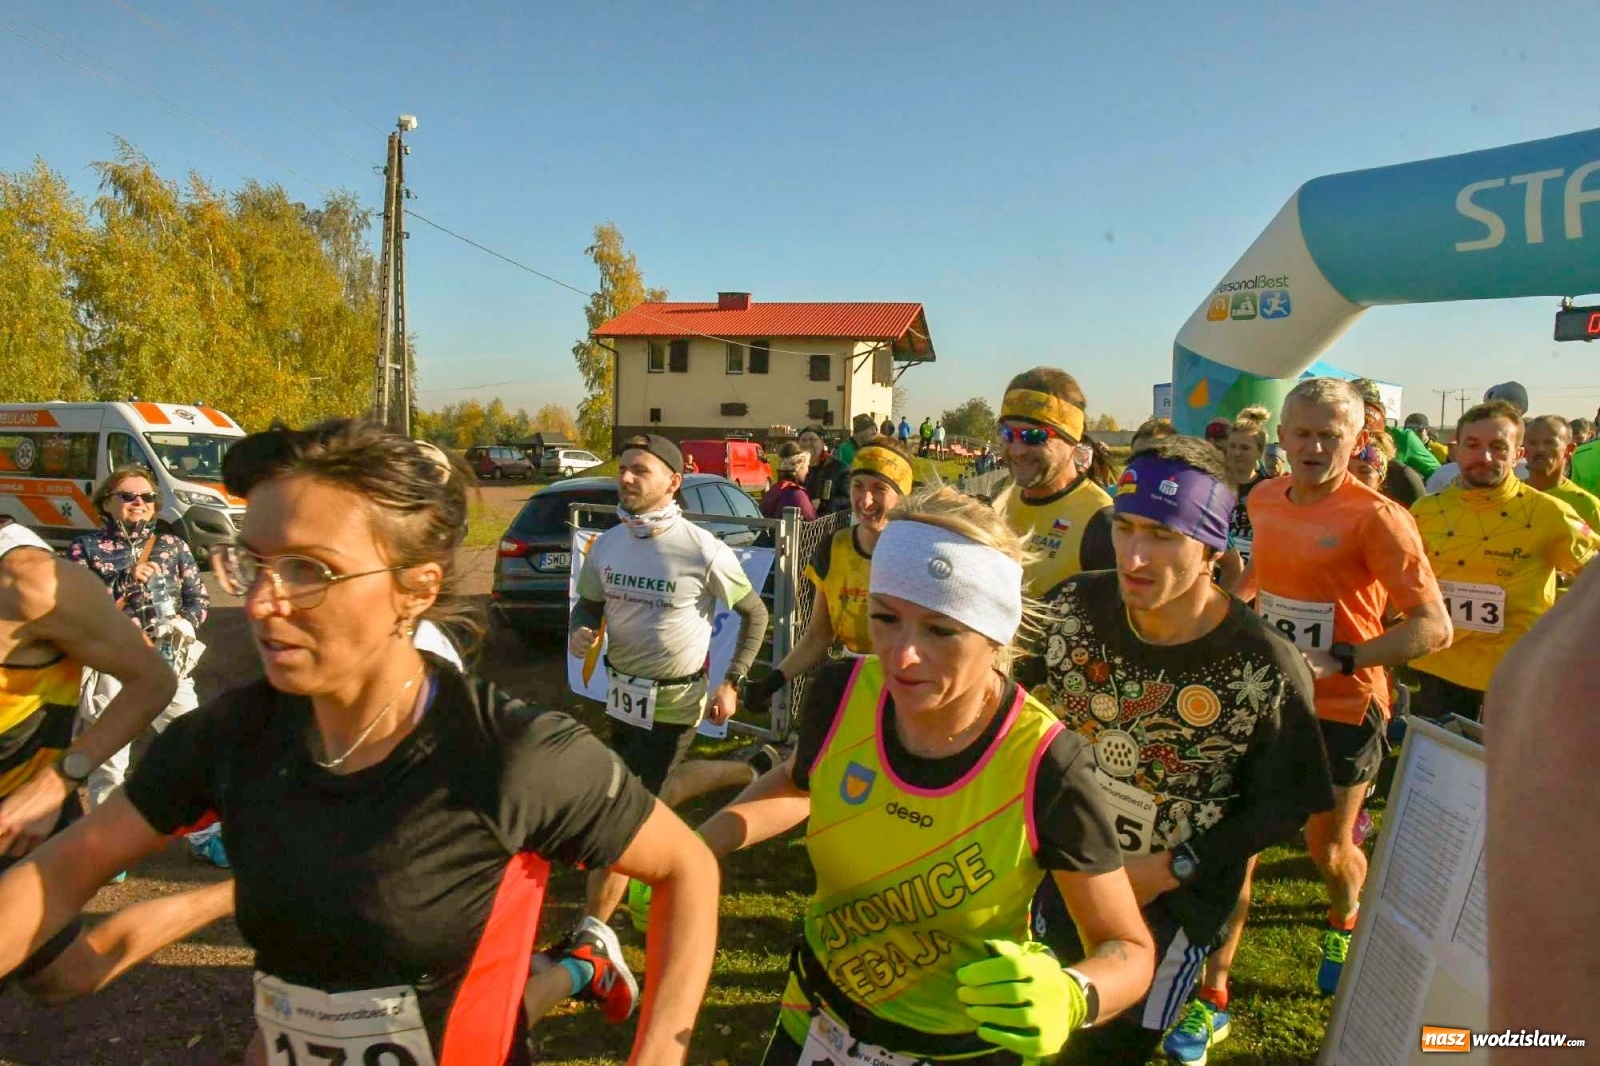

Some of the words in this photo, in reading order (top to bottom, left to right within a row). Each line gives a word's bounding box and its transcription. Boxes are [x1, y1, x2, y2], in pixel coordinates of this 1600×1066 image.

[546, 552, 566, 566] SWD
[606, 573, 677, 594] HEINEKEN
[612, 687, 649, 719] 191
[885, 801, 934, 829] deep
[821, 841, 997, 952] JKOWICE
